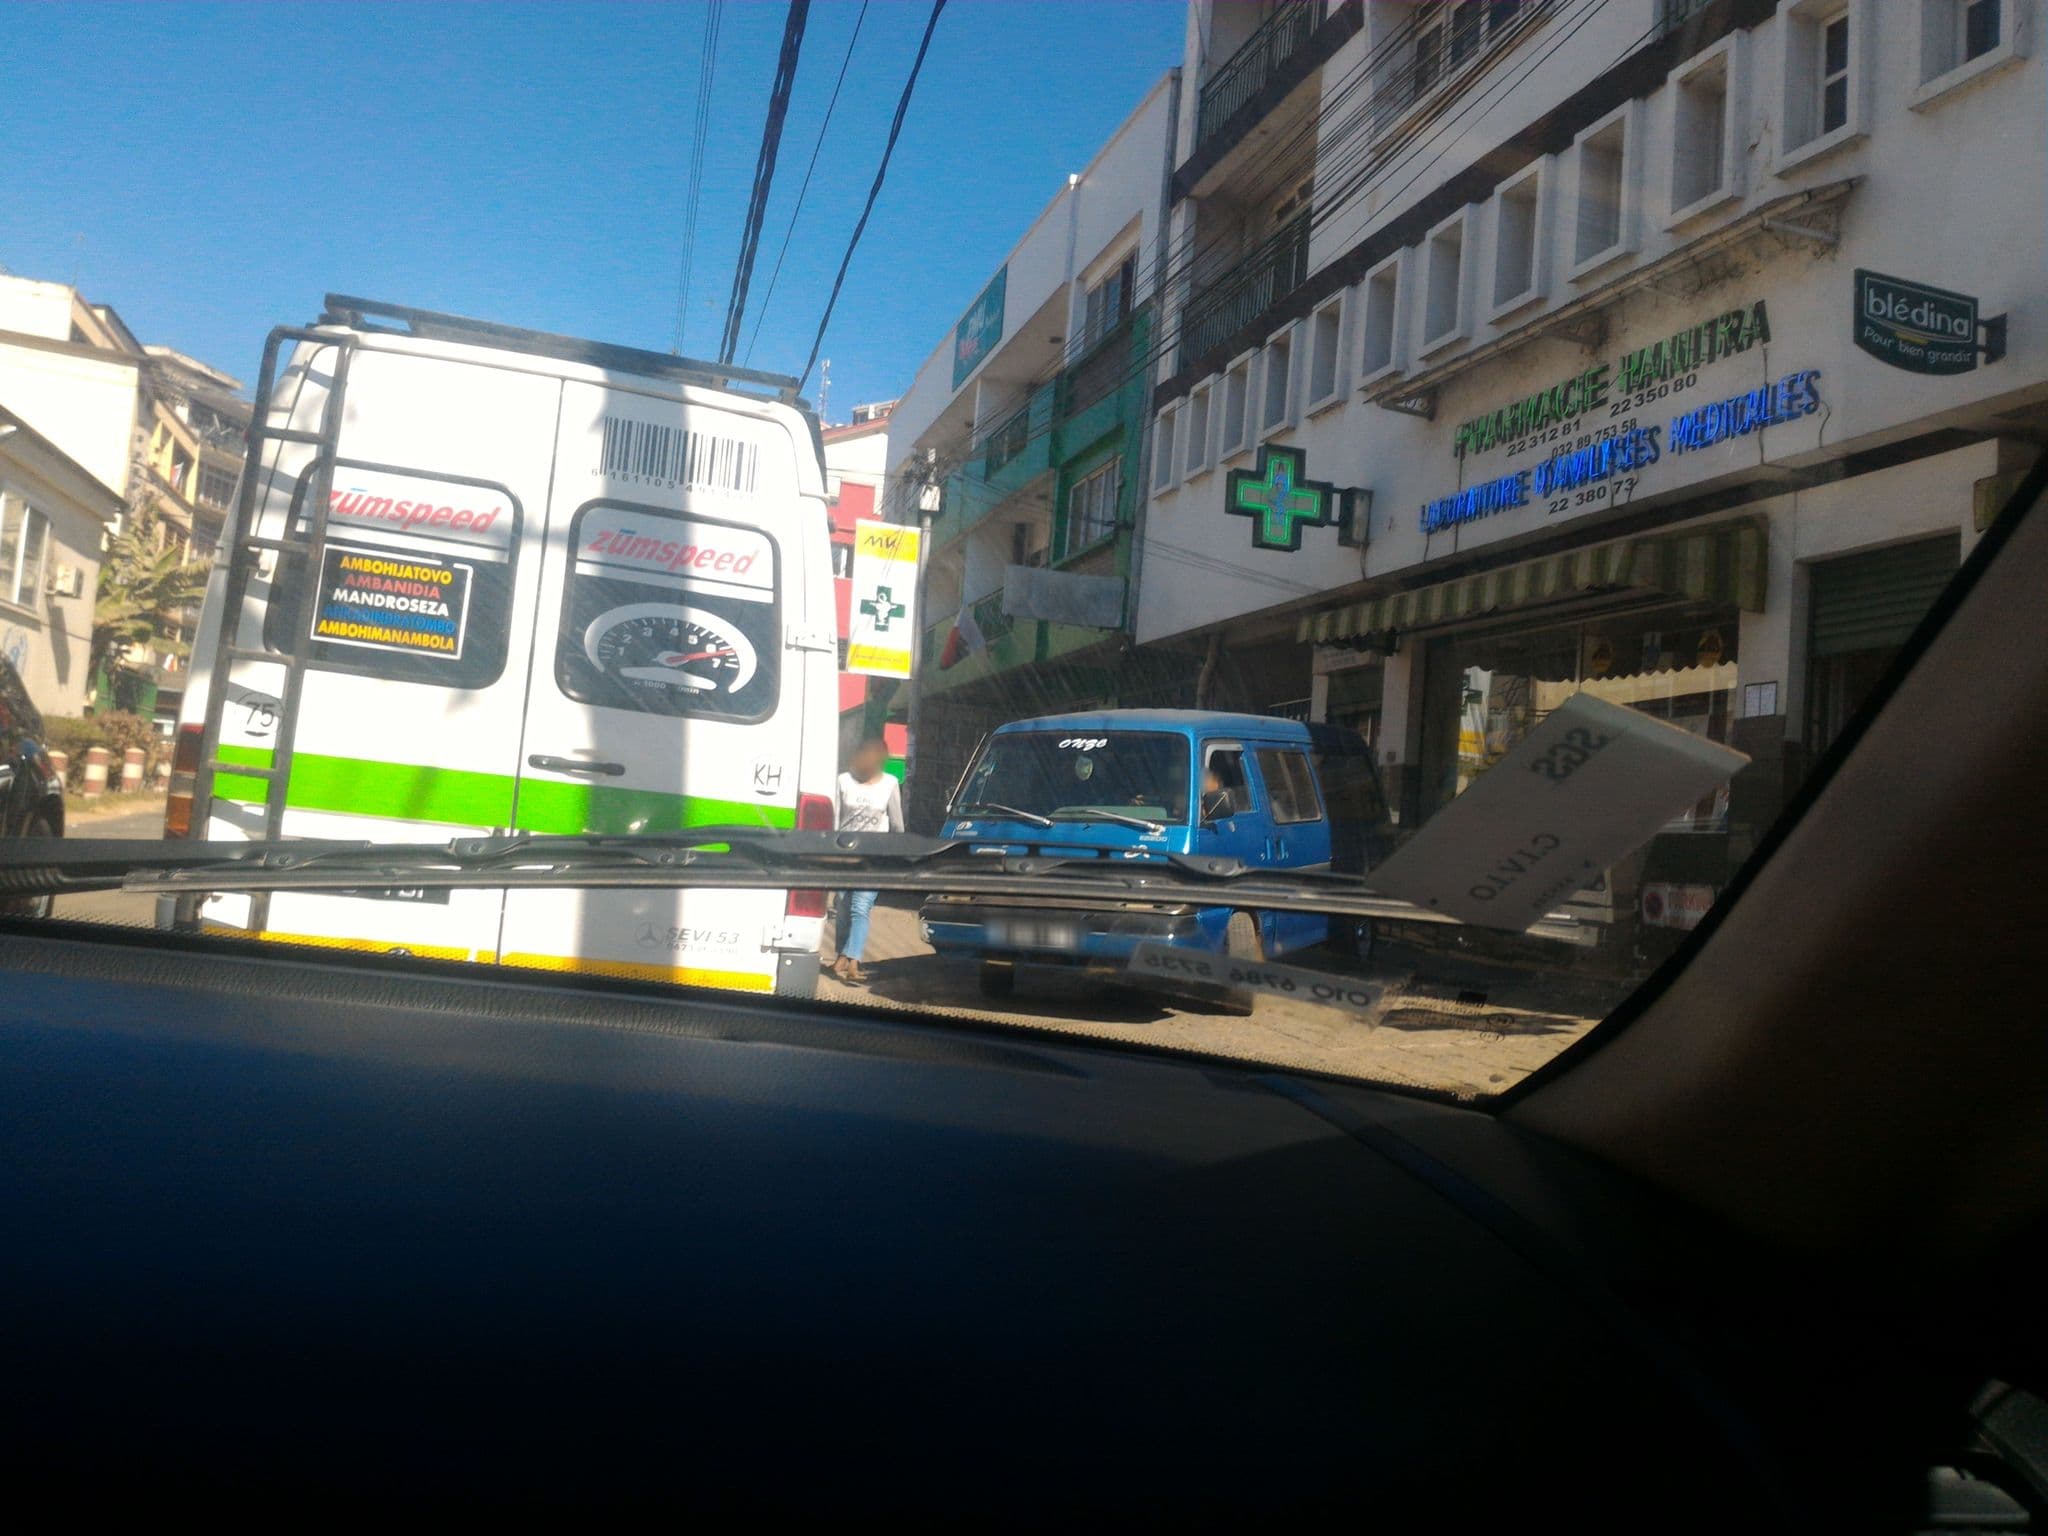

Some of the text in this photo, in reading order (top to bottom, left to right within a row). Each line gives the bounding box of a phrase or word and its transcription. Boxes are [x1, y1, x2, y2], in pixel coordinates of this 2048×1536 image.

[1868, 287, 1970, 336] blédina
[1453, 362, 1610, 460] PHARMACIE
[1548, 498, 1569, 514] 22
[1575, 486, 1607, 506] 380
[340, 554, 453, 585] AMBOHIJATOVO
[344, 573, 441, 600] AMBANIDIA
[332, 587, 450, 617] MANDROSEZA
[317, 619, 455, 651] AMBOHIMANAMBOLA
[753, 763, 783, 787] KH
